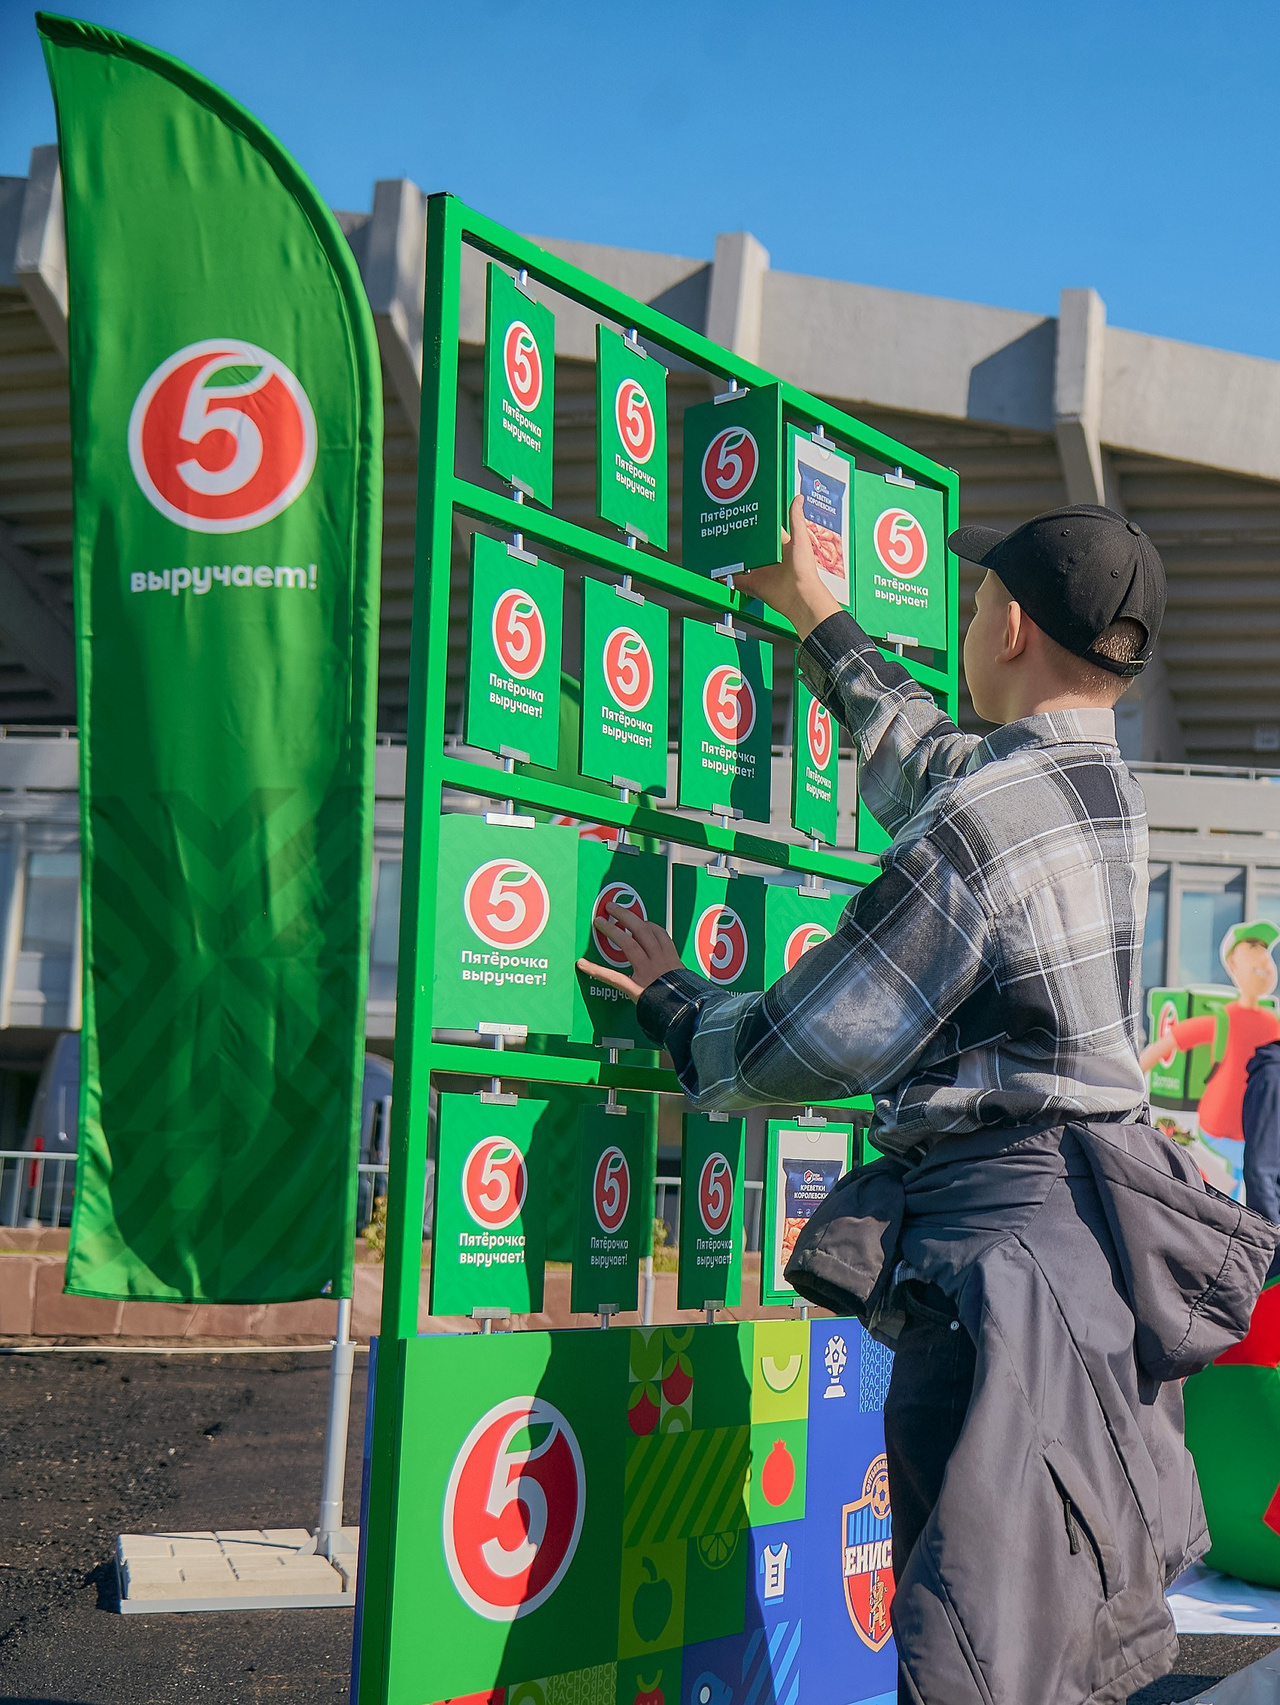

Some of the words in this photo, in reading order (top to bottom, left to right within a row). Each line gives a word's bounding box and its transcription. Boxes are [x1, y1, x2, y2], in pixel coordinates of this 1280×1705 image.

[502, 399, 542, 438] Пятёрочка
[502, 417, 541, 453] выручает!
[615, 453, 656, 488] Пятёрочка
[615, 471, 655, 501] выручает!
[700, 501, 759, 524] Пятёрочка
[701, 515, 758, 538] выручает!
[130, 564, 318, 596] выручает!
[873, 574, 929, 597] Пятёрочка
[875, 588, 928, 608] выручает!
[489, 672, 544, 702] Пятёрочка
[489, 691, 543, 718] выручает!
[601, 706, 653, 734] Пятёрочка
[602, 723, 652, 748] выручает!
[701, 740, 756, 764] Пятёрочка
[701, 757, 755, 778] выручает!
[805, 766, 832, 789] Пятёрочка
[805, 783, 832, 802] выручает!
[461, 950, 549, 969] Пятёрочка
[462, 969, 547, 986] выручает!
[800, 1184, 826, 1192] КРЕВЕТКИ
[459, 1232, 526, 1249] Пятёрочка
[590, 1236, 629, 1251] Пятёрочка
[696, 1238, 733, 1251] Пятёрочка
[459, 1251, 525, 1267] выручает!
[590, 1254, 628, 1268] выручает!
[696, 1253, 732, 1267] выручает!
[546, 1661, 618, 1690] КРАСНОЯРСК
[544, 1677, 617, 1704] КРАСНОЯРСК
